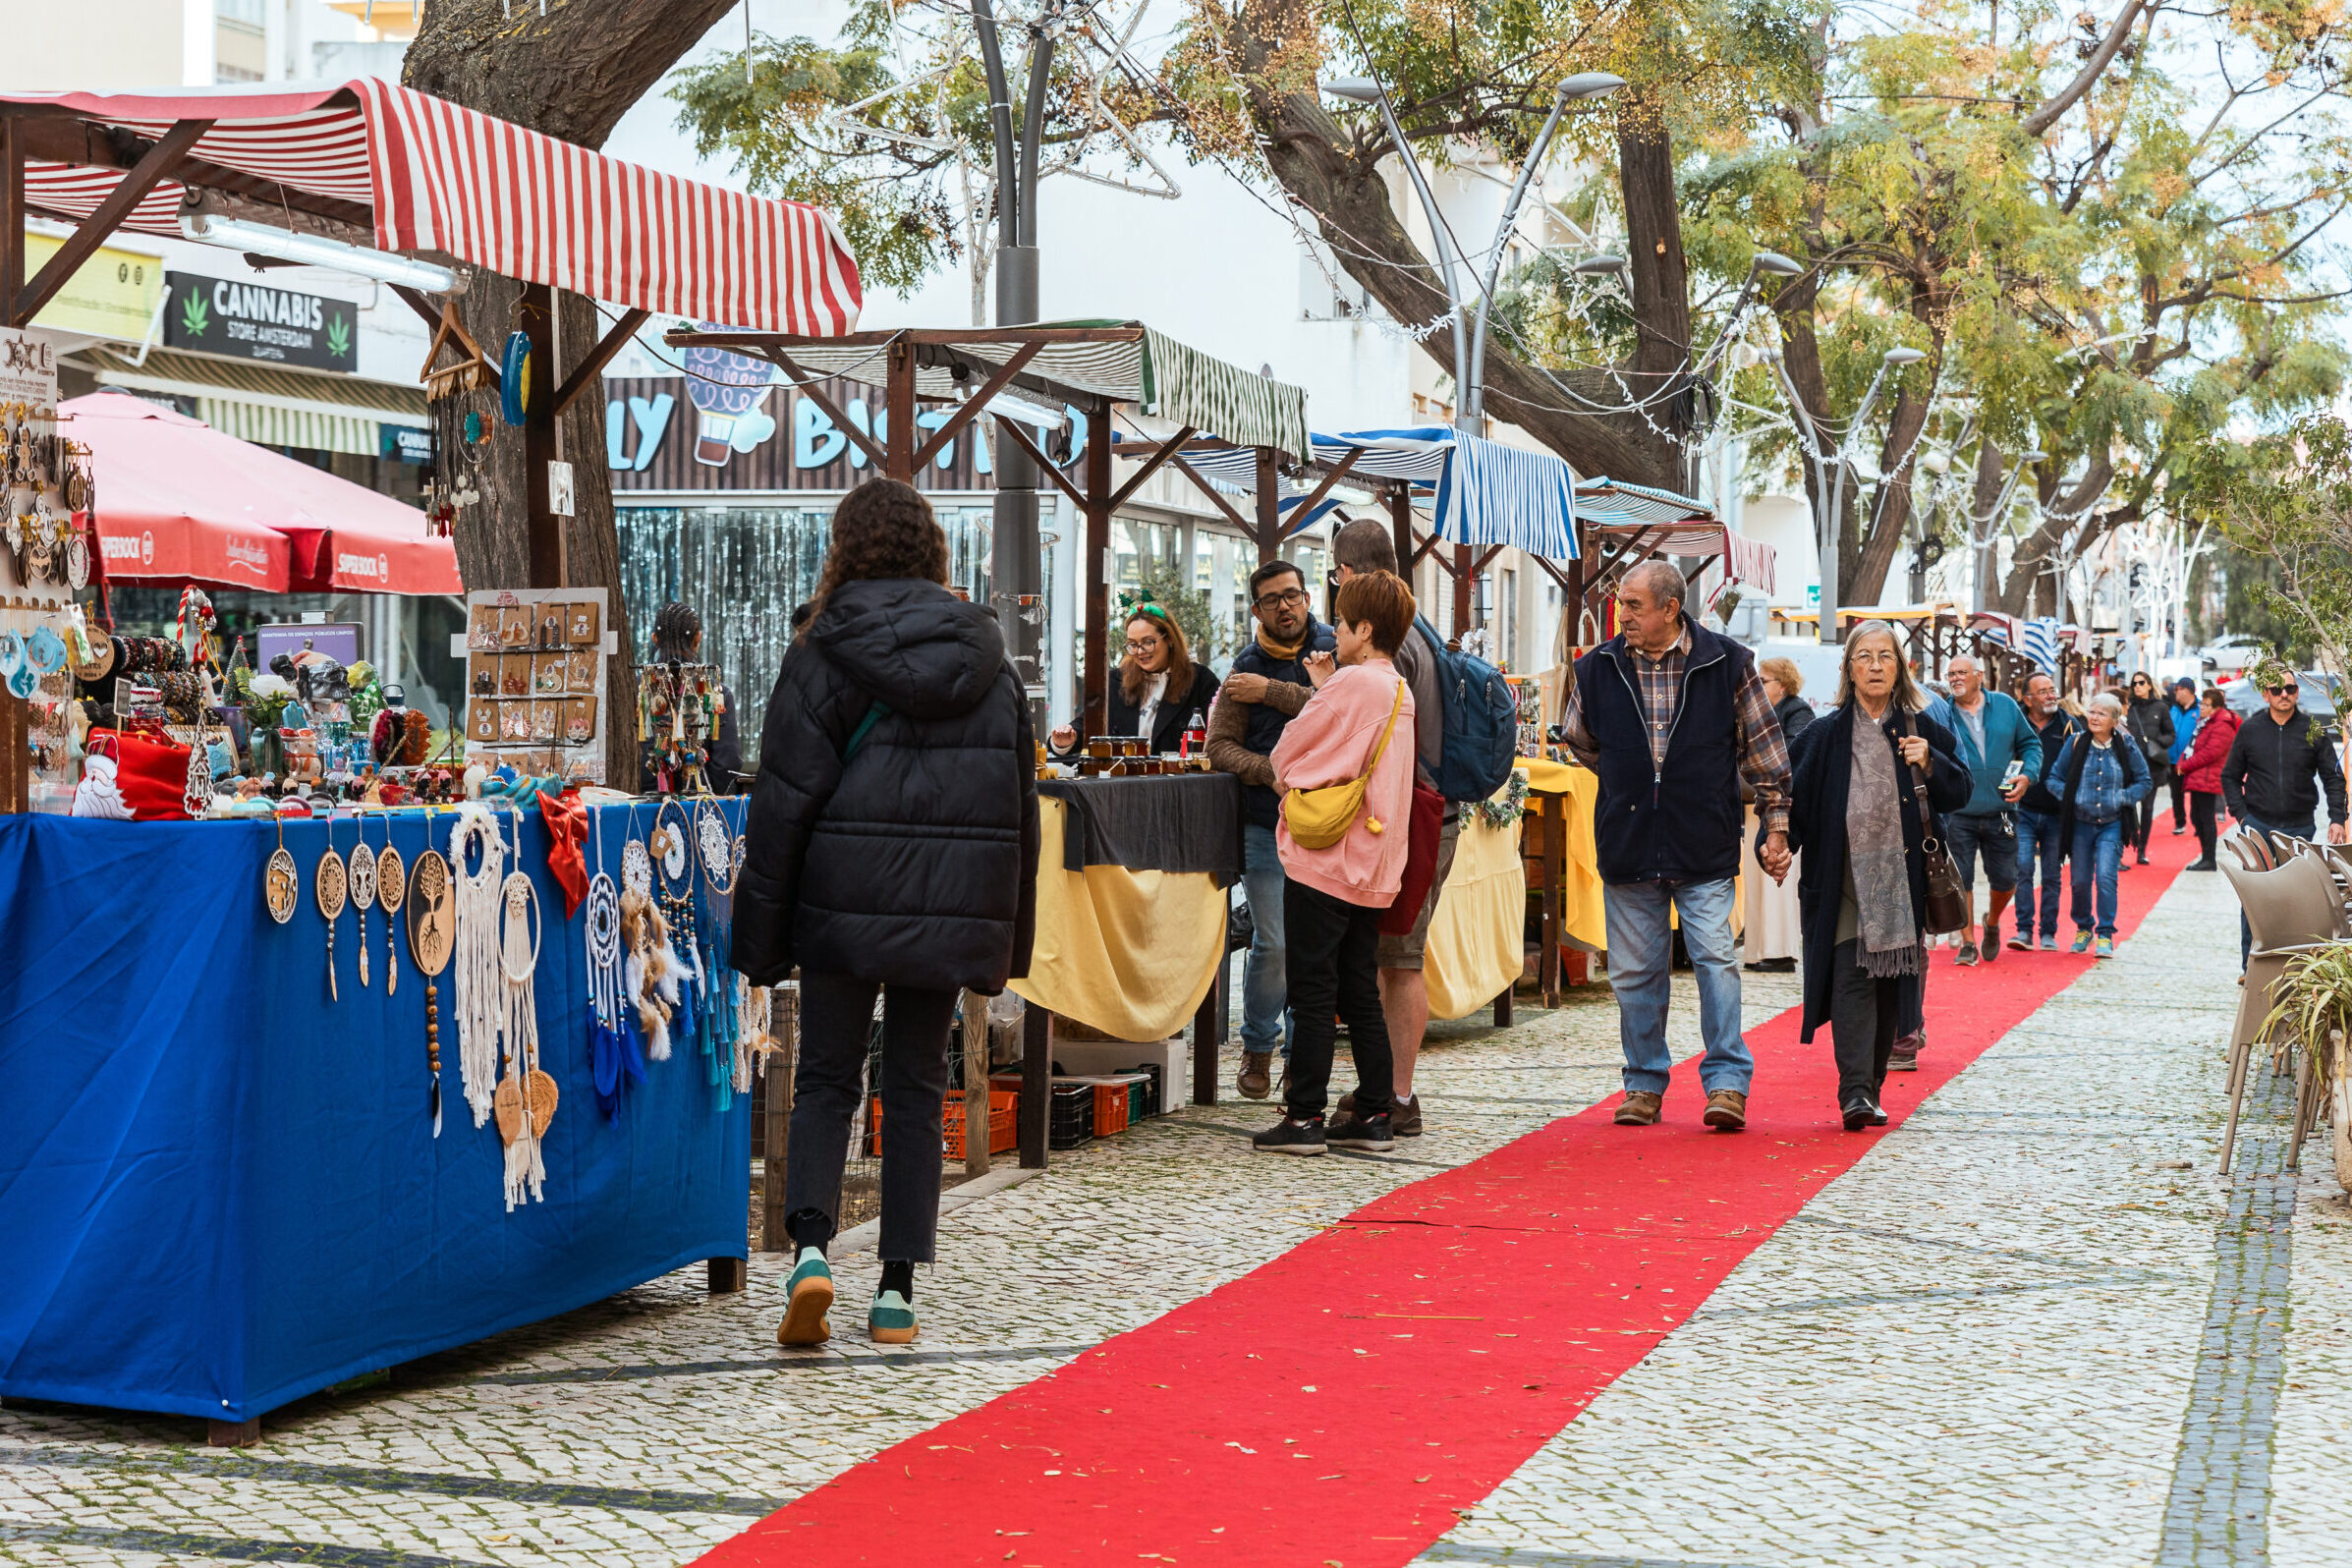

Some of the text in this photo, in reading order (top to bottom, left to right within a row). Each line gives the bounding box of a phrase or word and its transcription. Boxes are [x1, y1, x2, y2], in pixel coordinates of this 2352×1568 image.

[213, 281, 322, 330] CANNABIS
[227, 320, 312, 349] STORE AMSTERDAM
